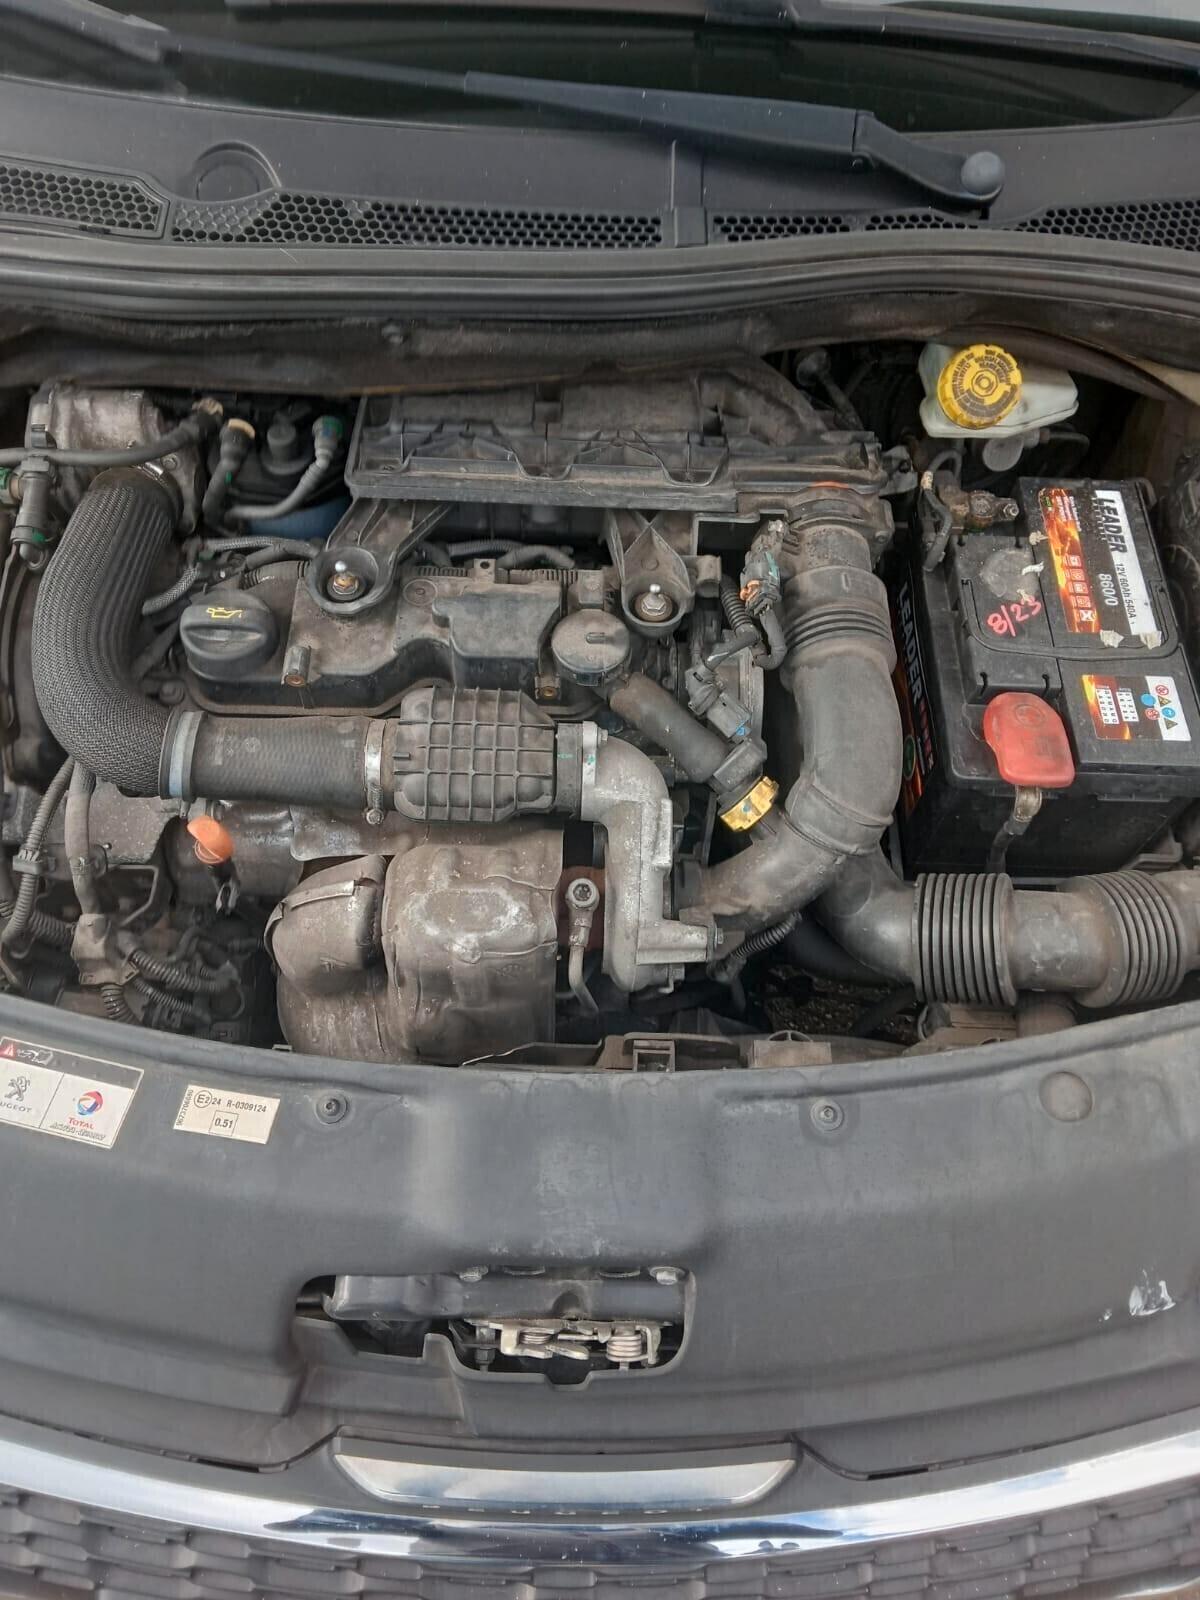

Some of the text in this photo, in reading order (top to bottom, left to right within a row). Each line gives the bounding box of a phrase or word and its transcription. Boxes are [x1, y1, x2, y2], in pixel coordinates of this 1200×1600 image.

[1098, 498, 1128, 554] LEADER
[1115, 562, 1127, 579] 12V
[1098, 573, 1119, 606] 860/0
[987, 595, 1041, 637] 8/23
[899, 582, 922, 704] LEADER
[0, 1101, 32, 1113] UGEOT
[211, 1097, 222, 1105] 24
[226, 1099, 267, 1113] R-0309124
[68, 1117, 95, 1129] TOTAL
[214, 1117, 233, 1129] 0.51
